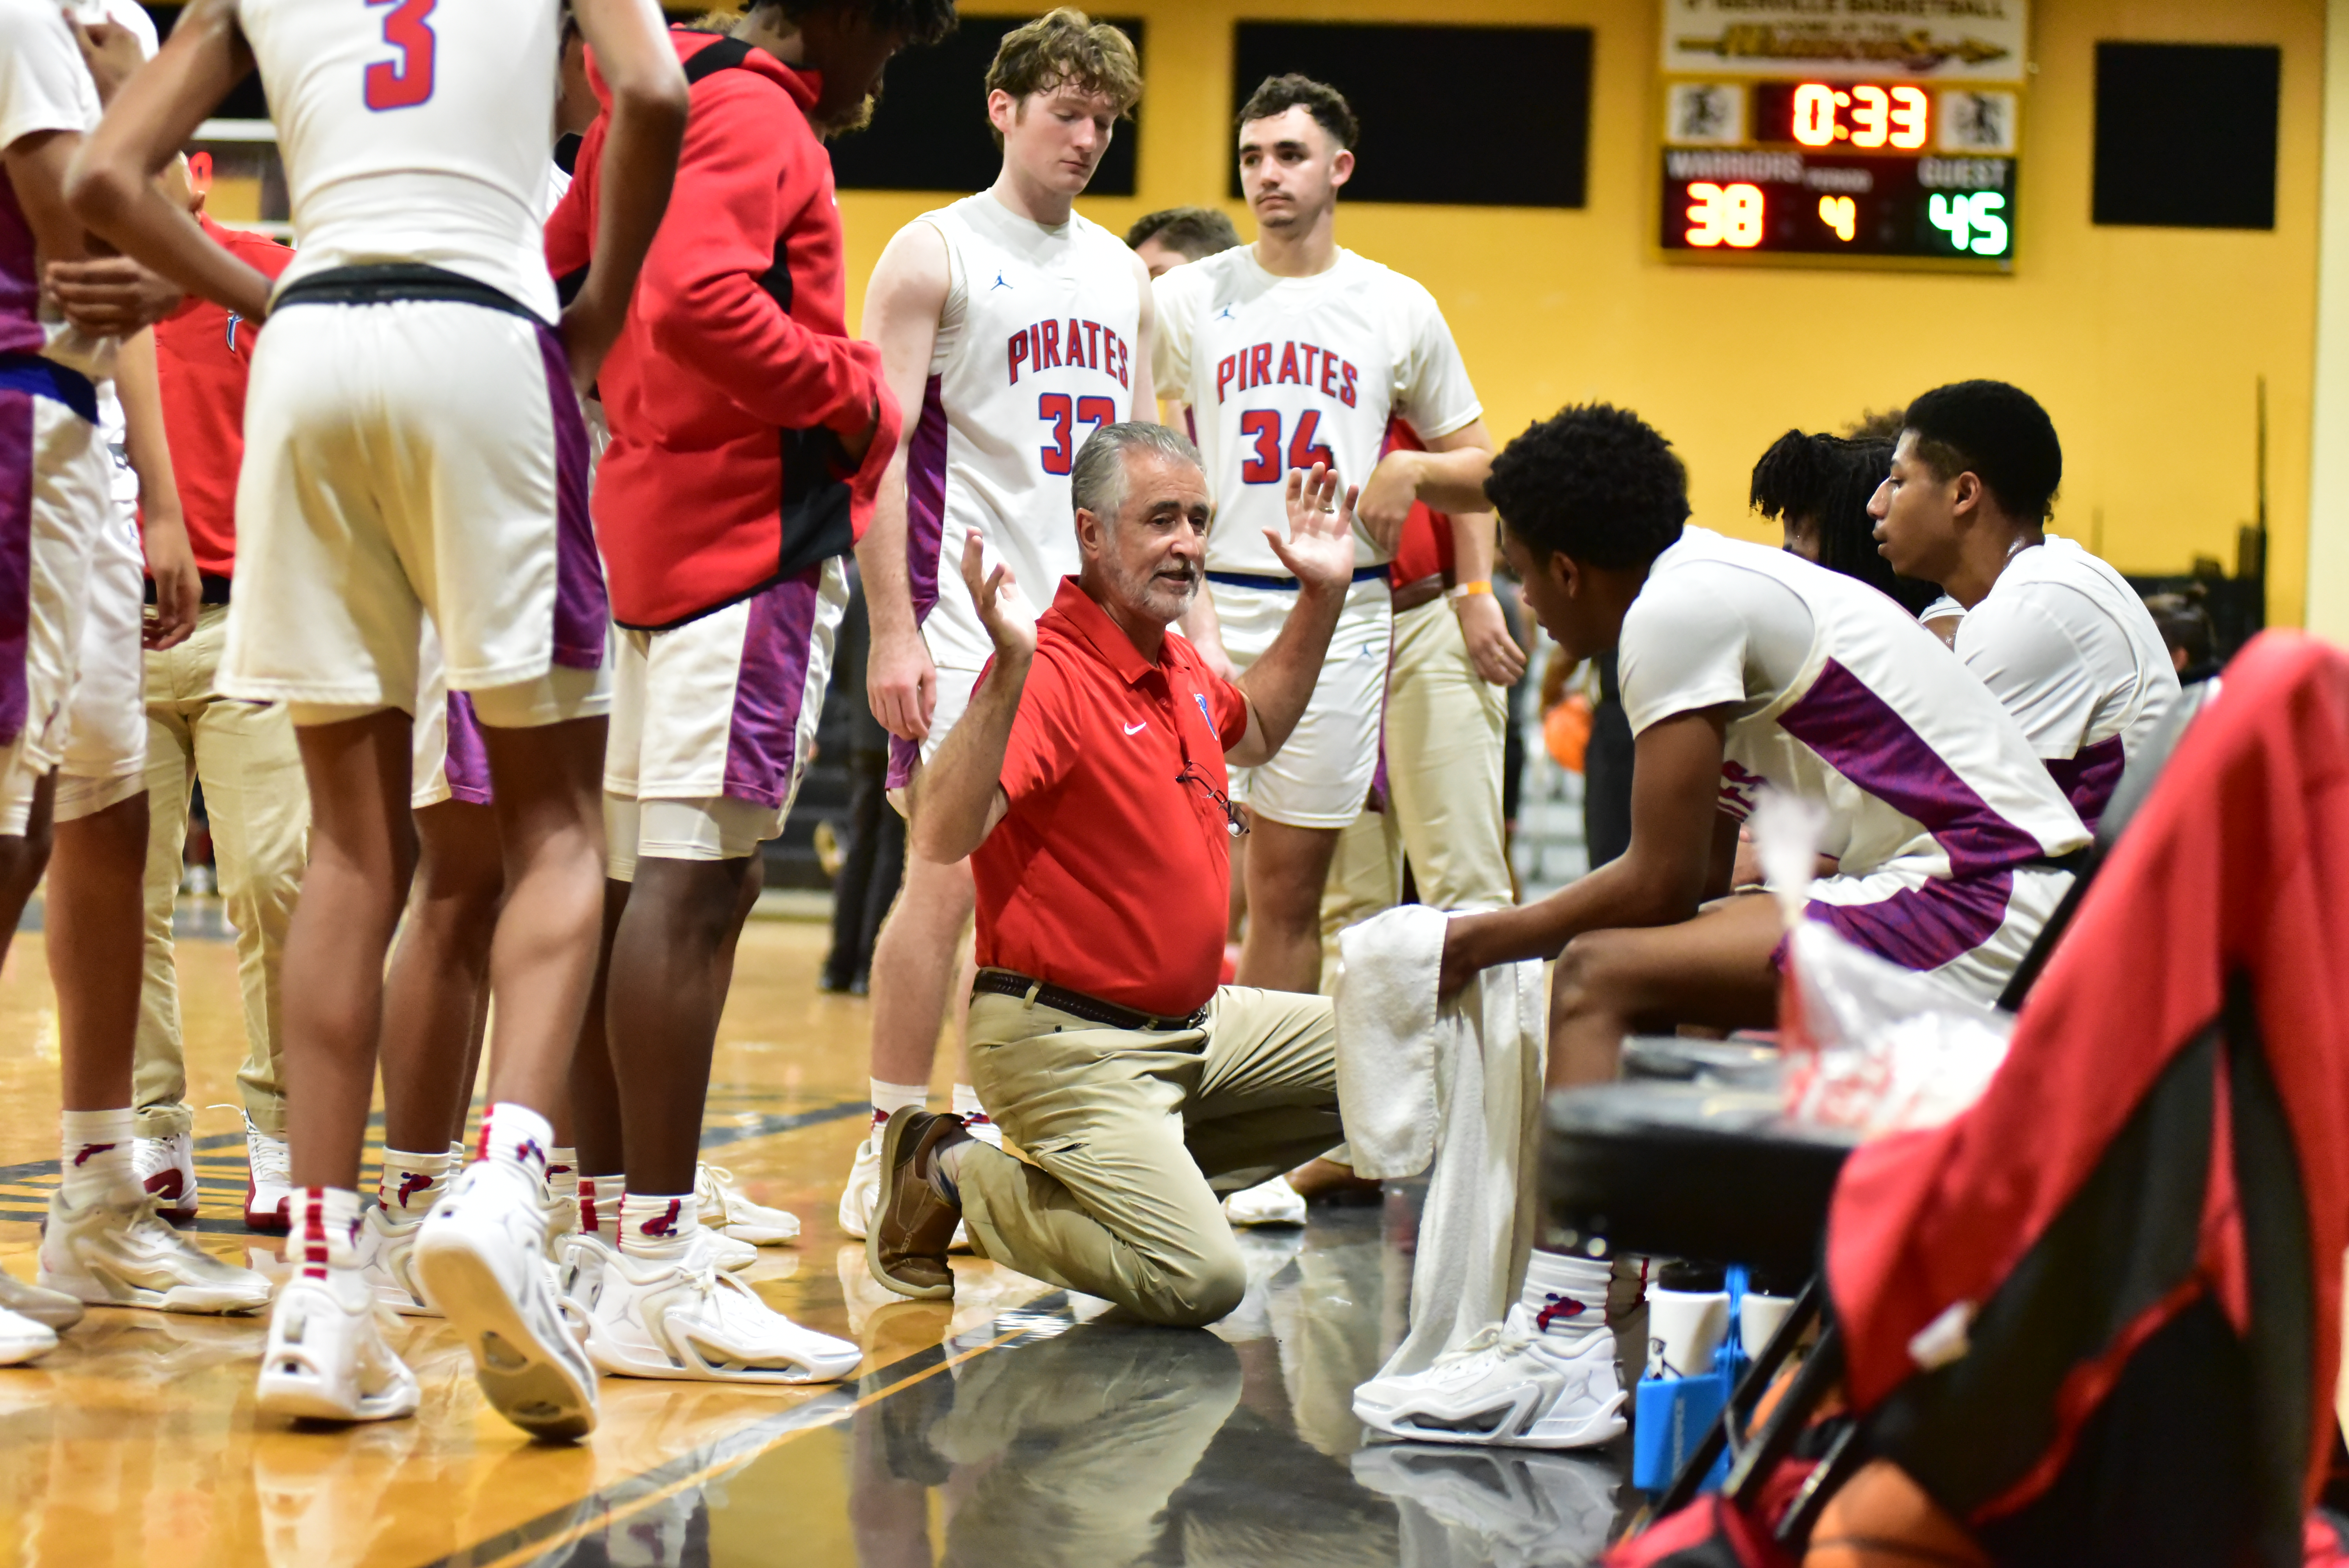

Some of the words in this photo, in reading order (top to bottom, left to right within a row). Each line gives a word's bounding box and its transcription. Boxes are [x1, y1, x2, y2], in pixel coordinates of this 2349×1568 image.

[363, 0, 437, 112] 3
[1793, 83, 1928, 149] 0:33
[1918, 157, 2008, 187] GUEST
[1685, 182, 1764, 248] 38
[1819, 195, 1856, 241] 4
[1929, 191, 2008, 256] 45
[1007, 317, 1129, 392] PIRATES
[1216, 340, 1358, 408] PIRATES
